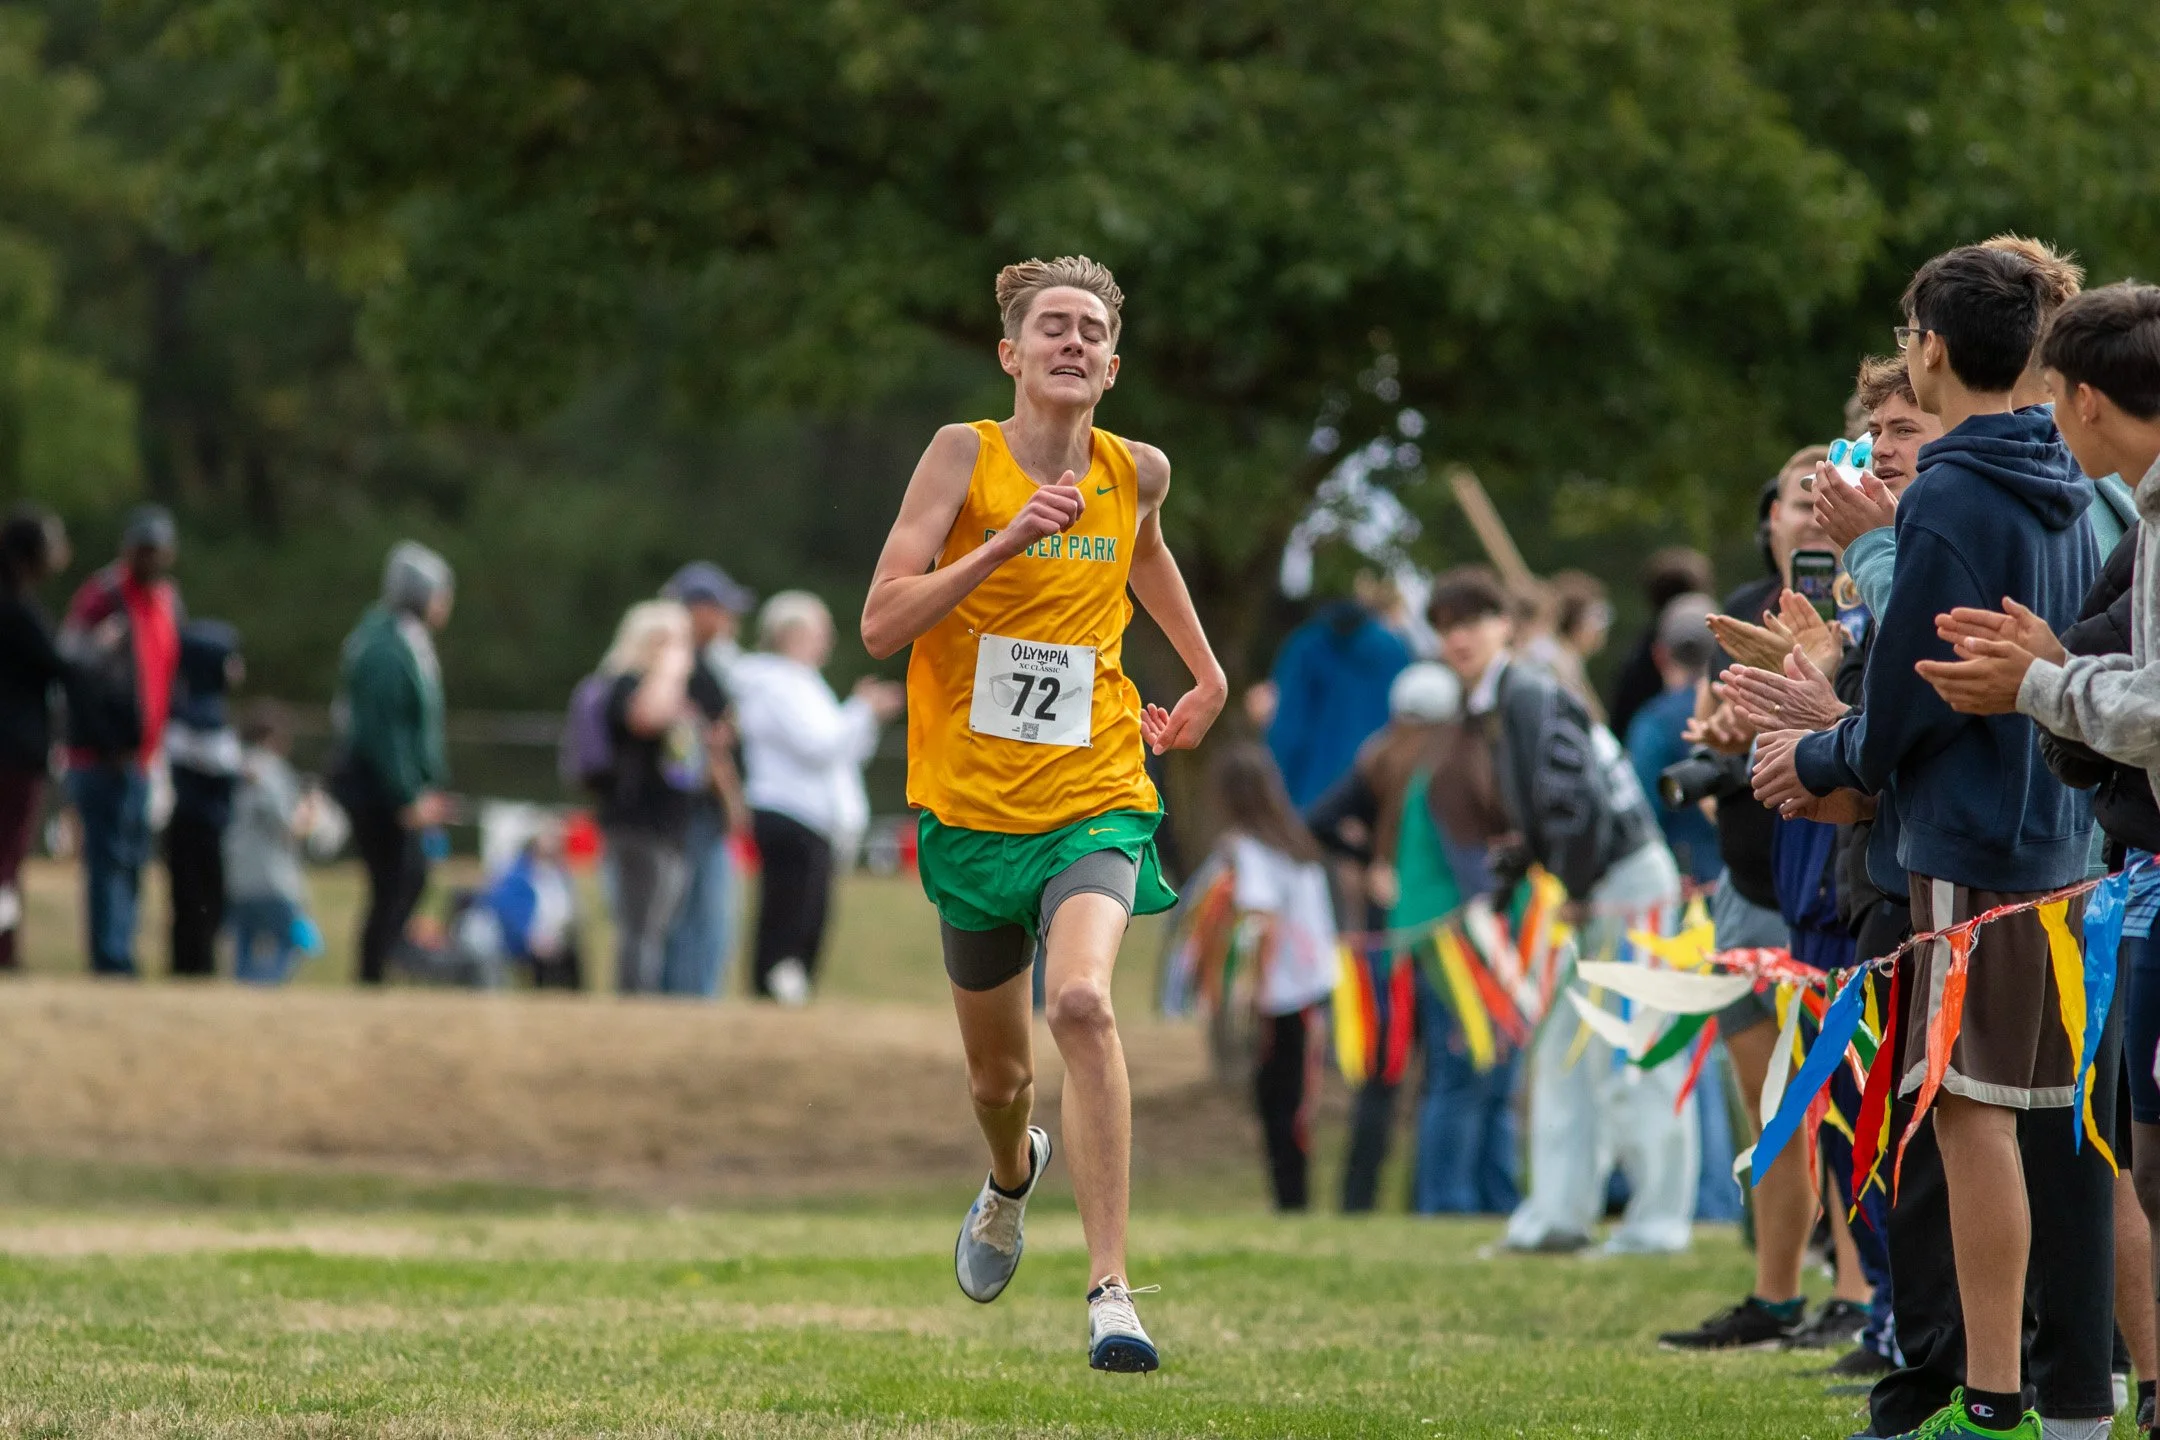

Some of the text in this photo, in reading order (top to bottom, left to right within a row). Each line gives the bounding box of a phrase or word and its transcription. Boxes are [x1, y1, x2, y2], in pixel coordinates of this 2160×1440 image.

[1068, 535, 1117, 562] PARK
[1011, 642, 1069, 669] OLYMPIA
[1019, 662, 1061, 674] XC CLASSIC
[1010, 672, 1061, 721] 72
